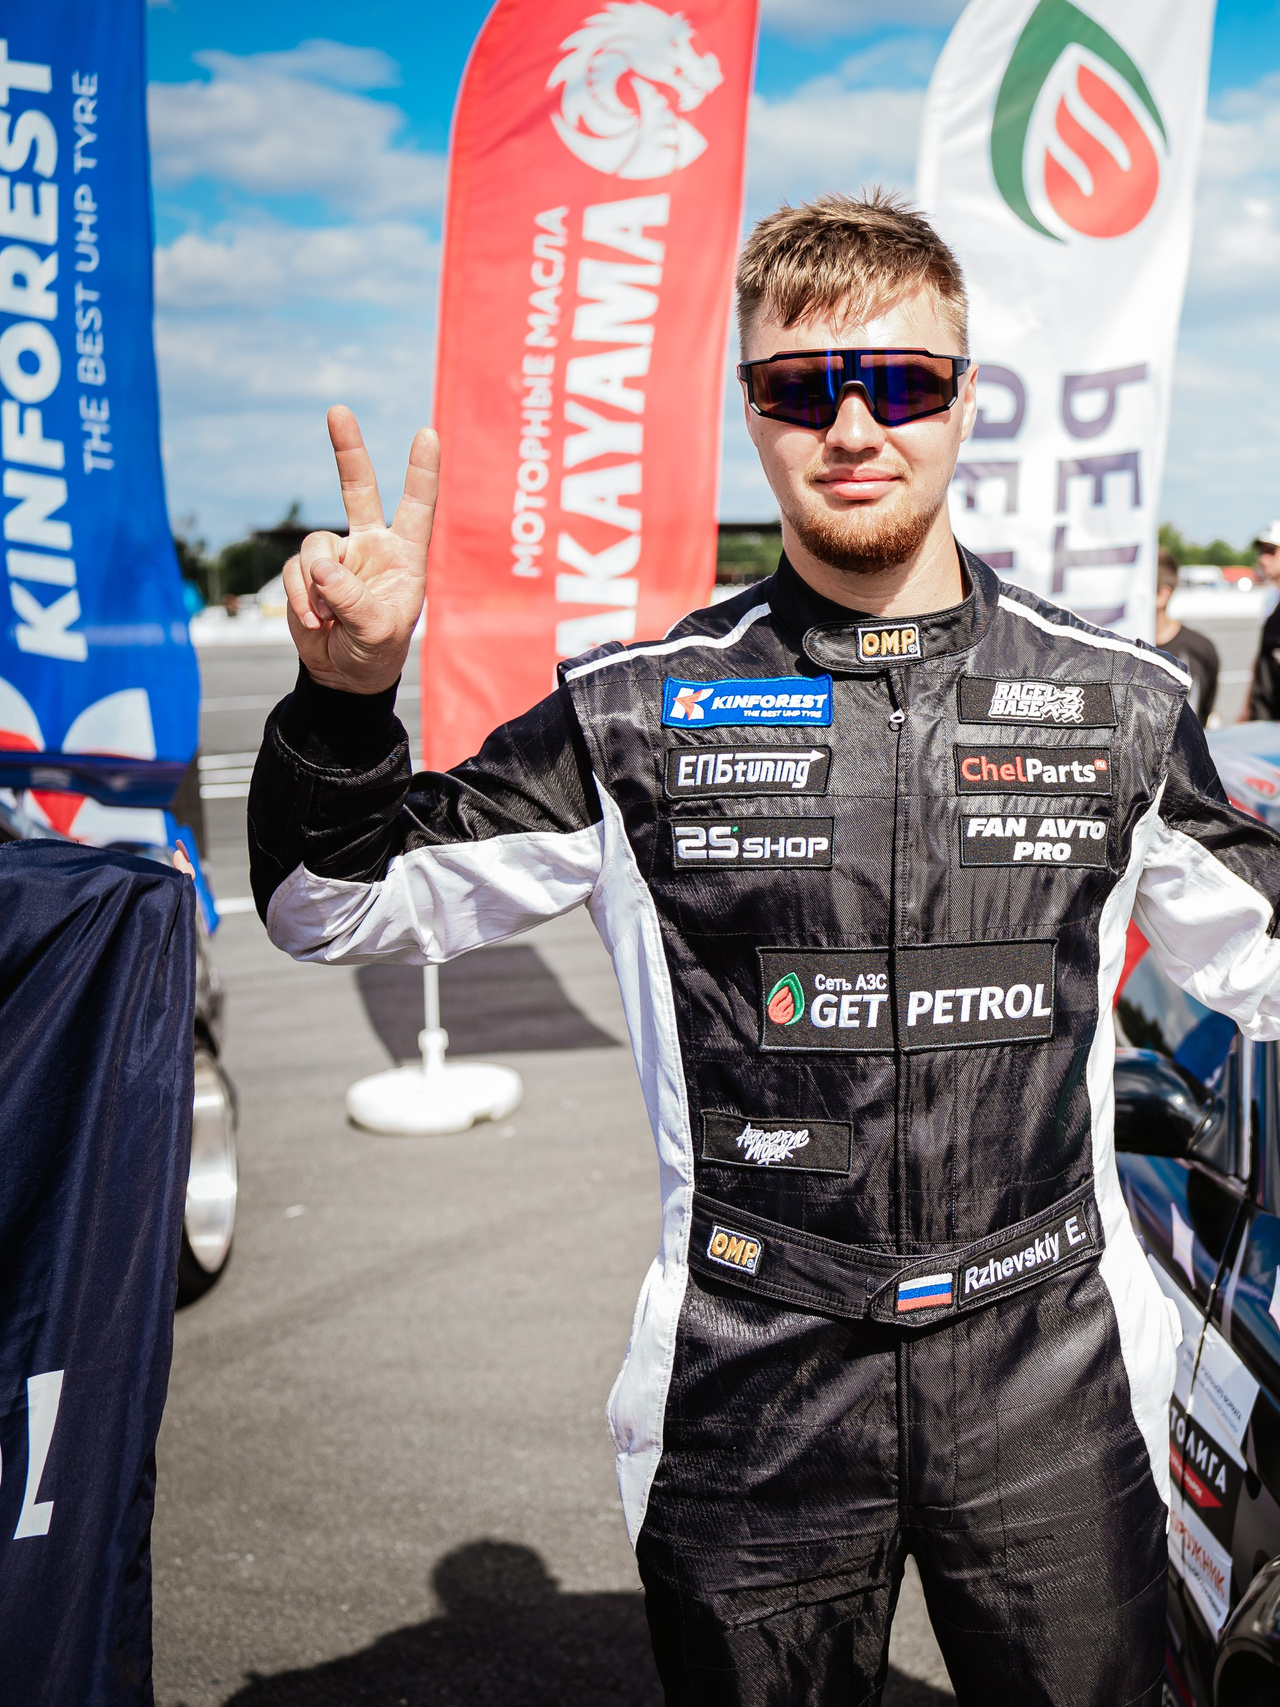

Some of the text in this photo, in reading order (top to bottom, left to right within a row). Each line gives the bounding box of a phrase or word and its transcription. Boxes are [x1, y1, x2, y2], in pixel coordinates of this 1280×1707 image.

[72, 70, 115, 476] THE BEST UHP TYRE
[0, 38, 88, 663] KINFOREST
[511, 205, 570, 578] МОТОРНЫЕ МАСЛА
[552, 193, 670, 690] AKAYAMA
[861, 628, 917, 657] OMP
[711, 693, 828, 710] KINFOREST
[760, 709, 782, 718] BEST
[801, 710, 822, 719] TYRE
[961, 756, 1097, 784] ChelParts
[966, 817, 1107, 840] FAN AVTO
[742, 836, 829, 859] SHOP
[1012, 842, 1072, 862] PRO
[814, 972, 888, 991] Сеть АЗС
[810, 983, 1052, 1028] GET PETROL
[710, 1231, 758, 1267] OMP
[963, 1217, 1088, 1295] Rzhevskiy E.
